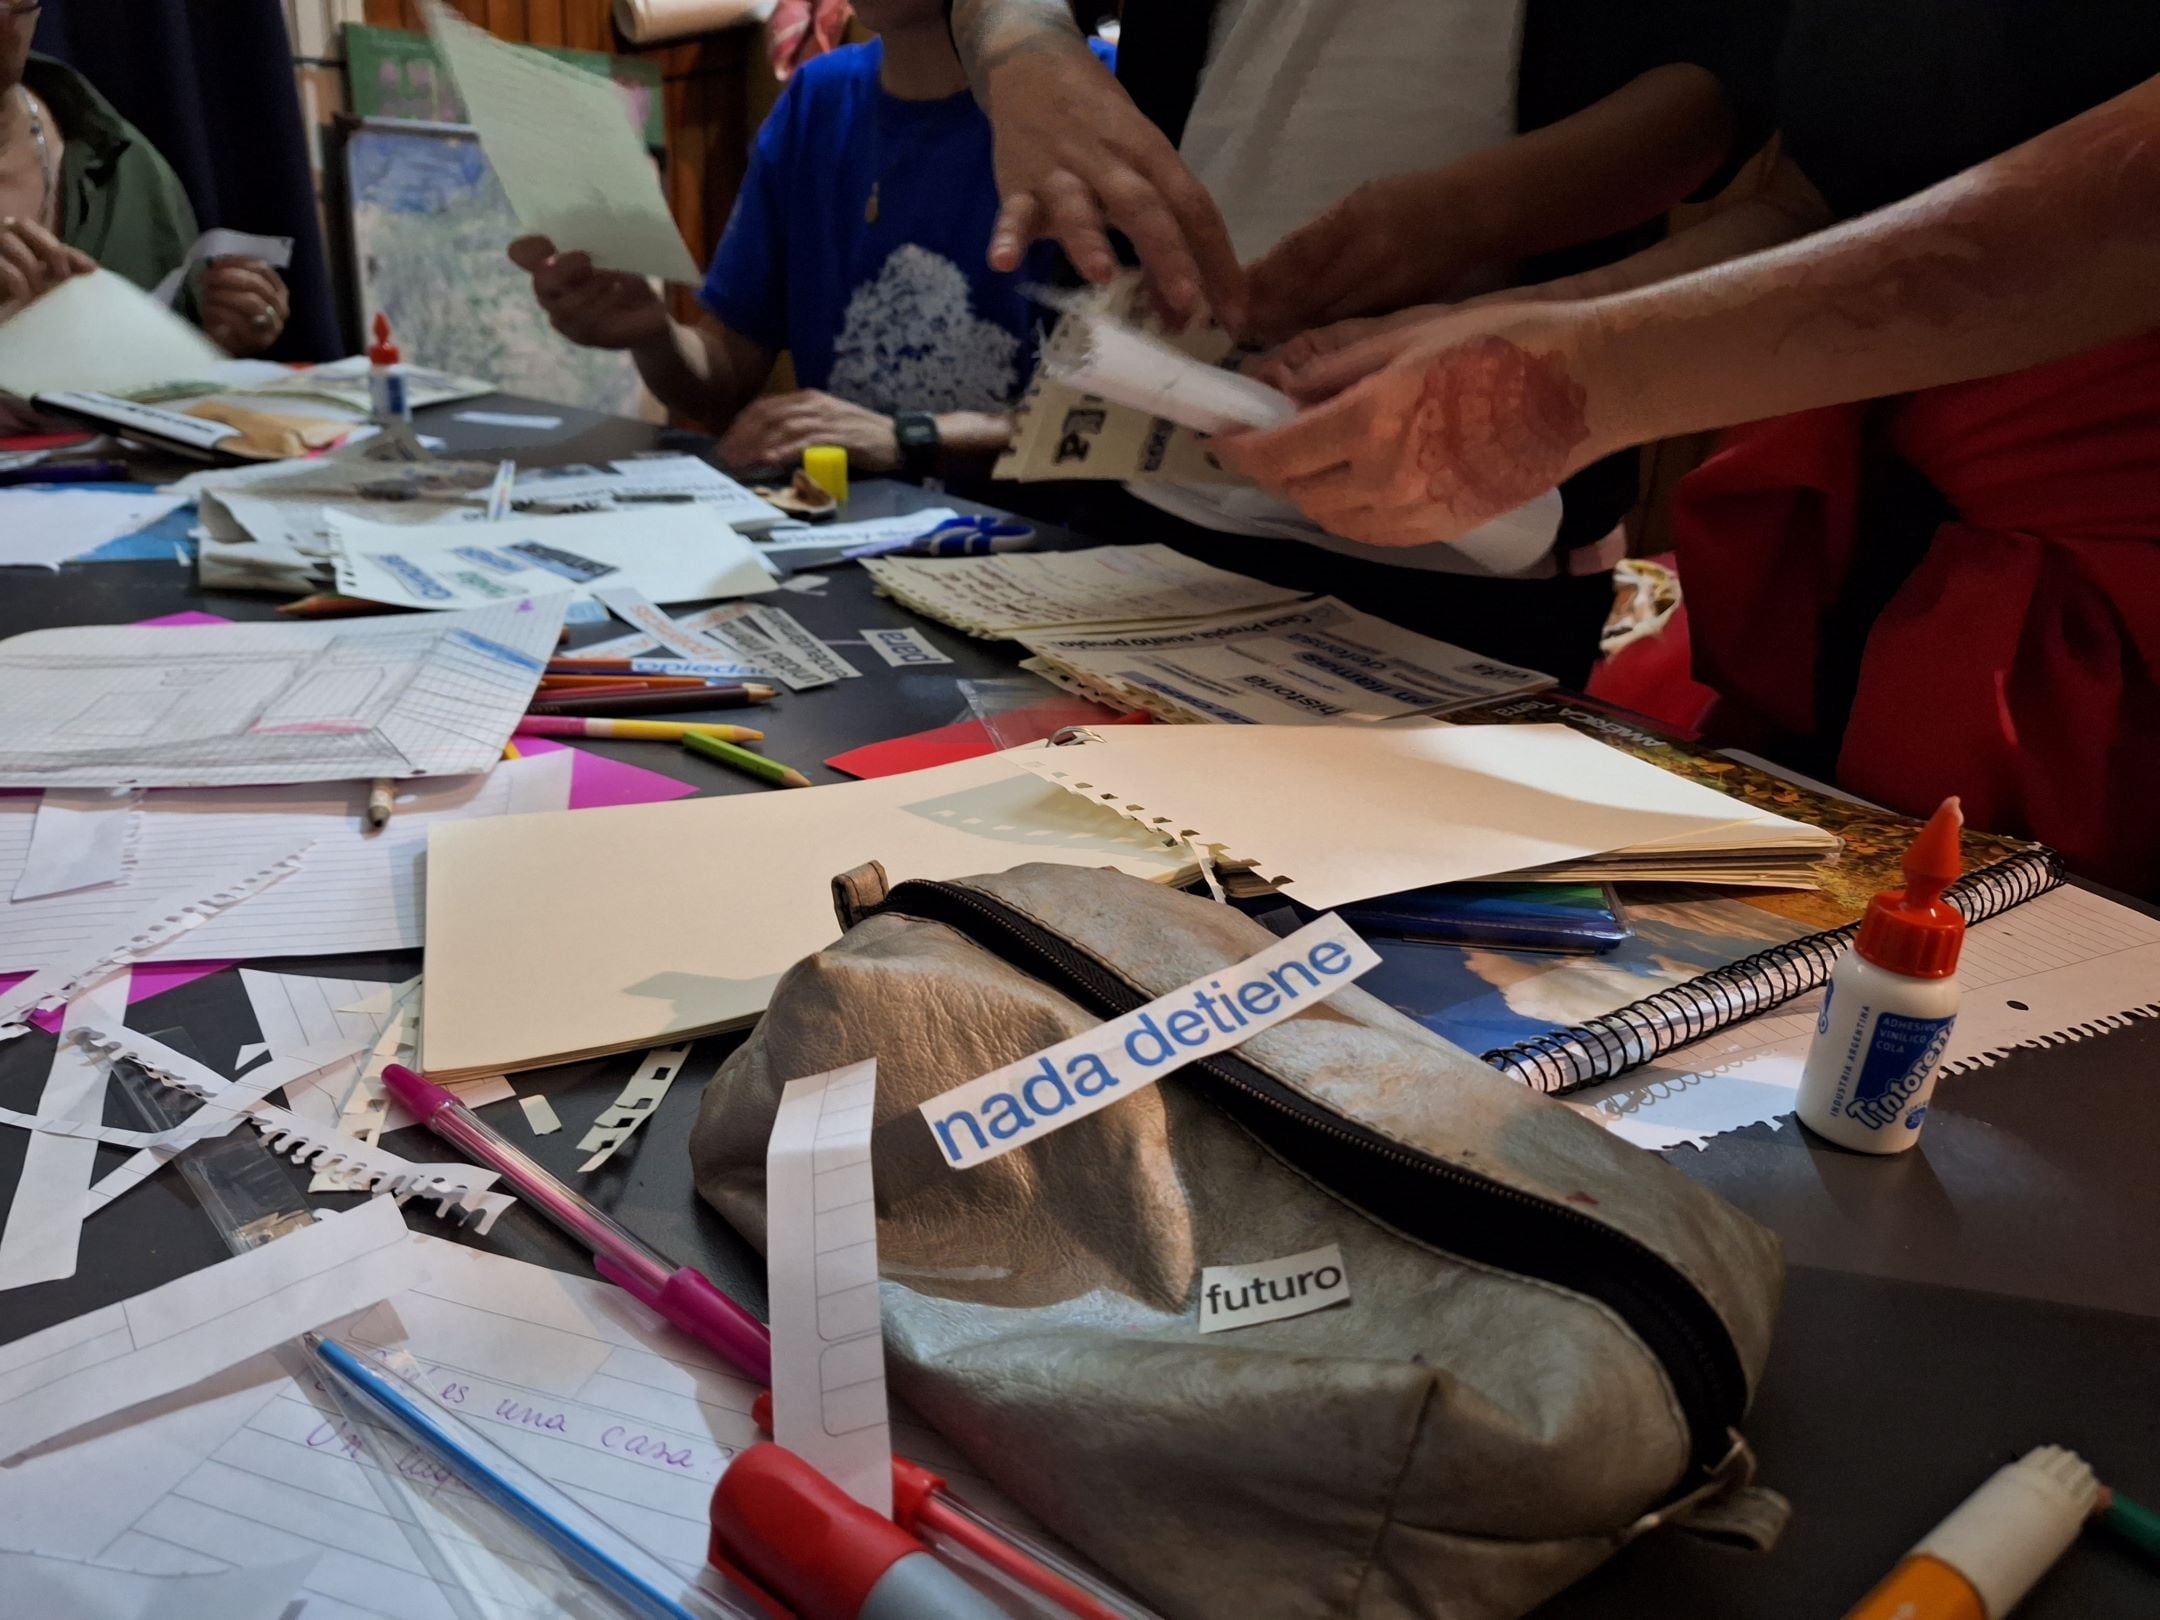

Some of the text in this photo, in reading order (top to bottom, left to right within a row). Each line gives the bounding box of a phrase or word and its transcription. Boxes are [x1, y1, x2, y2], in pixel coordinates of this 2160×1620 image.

[877, 630, 942, 663] para
[1245, 674, 1345, 716] historia
[1493, 699, 1557, 718] Terra
[934, 939, 1352, 1161] nada detiene
[1830, 1005, 1871, 1117] INDUSTRIA ARGENTINA
[1875, 1040, 1905, 1053] COLA
[1206, 1264, 1342, 1315] futuro
[441, 1382, 469, 1404] es
[495, 1397, 568, 1433] una
